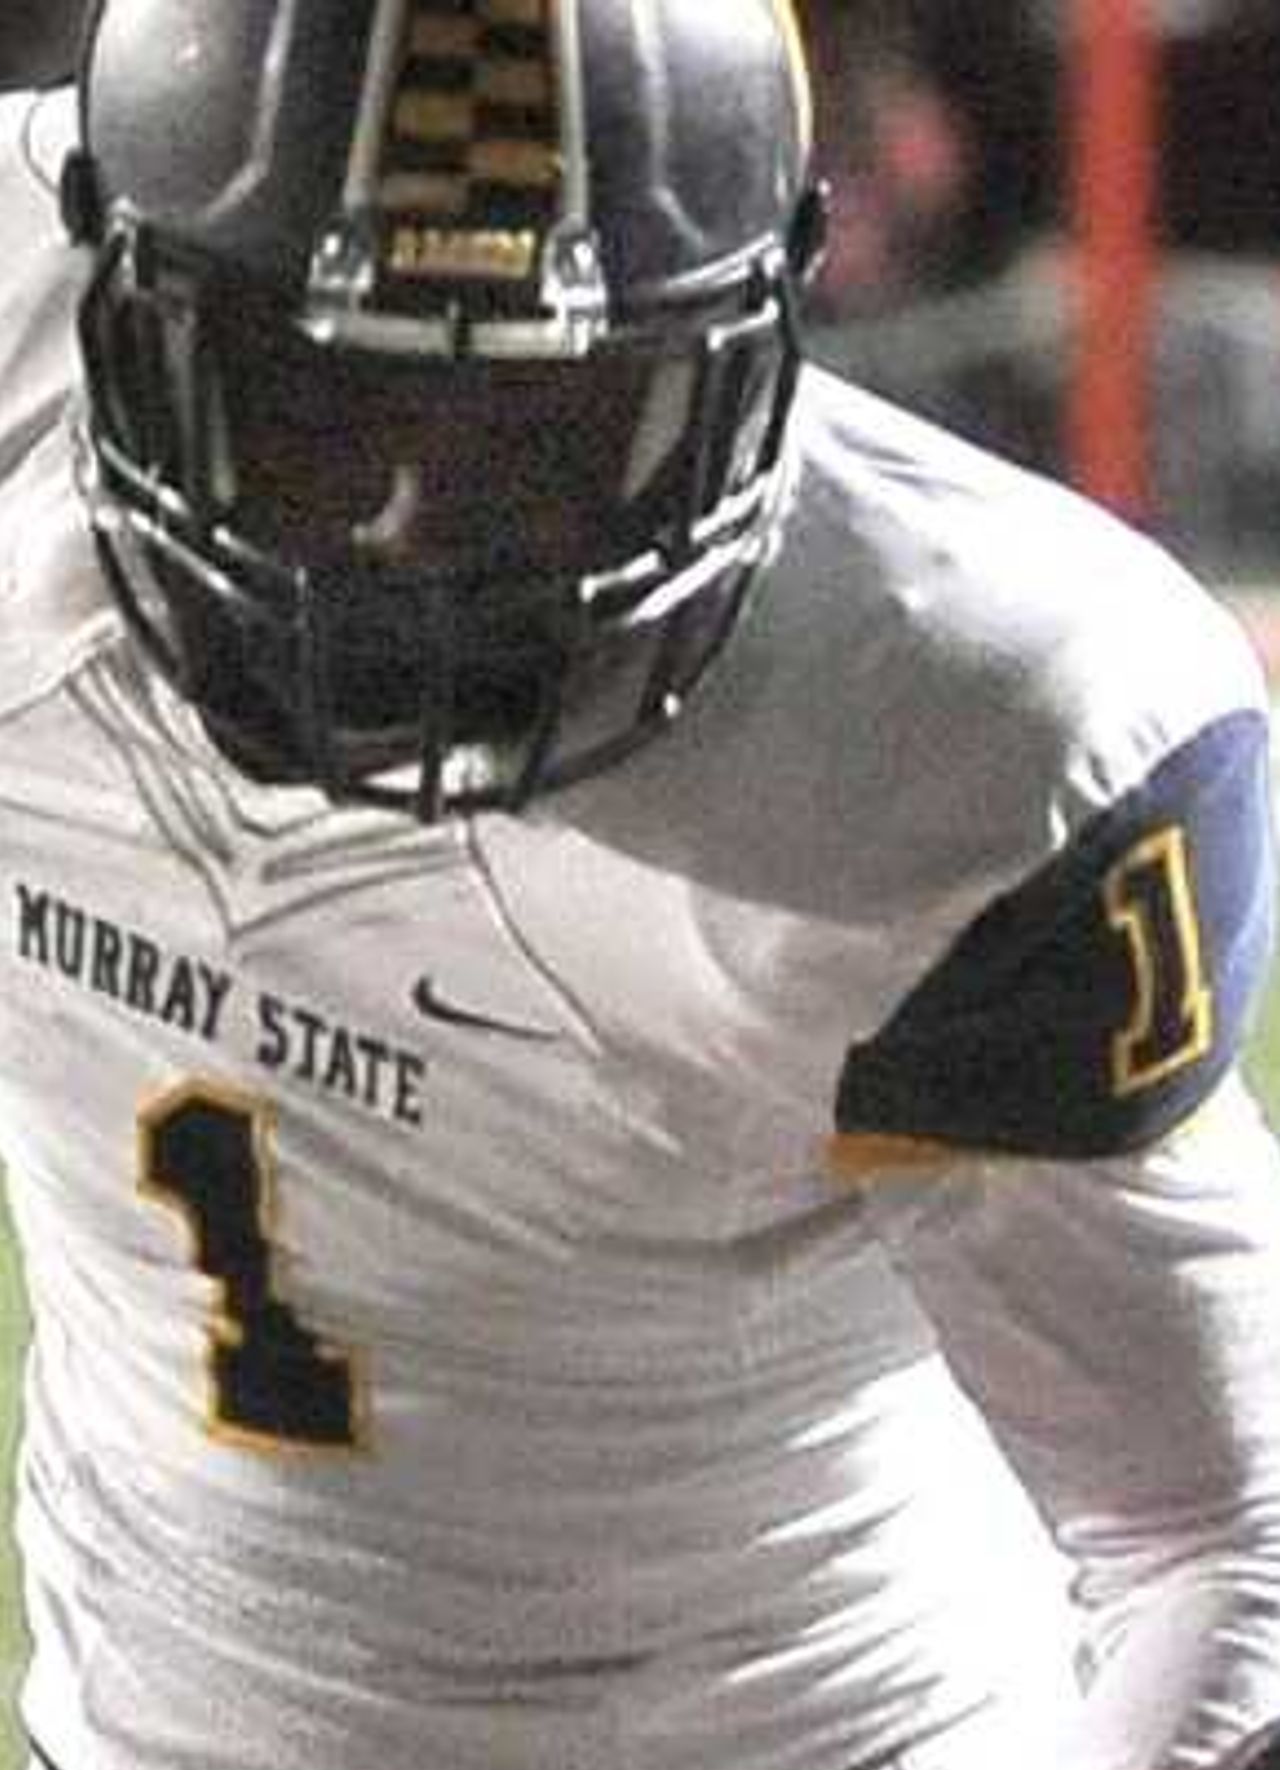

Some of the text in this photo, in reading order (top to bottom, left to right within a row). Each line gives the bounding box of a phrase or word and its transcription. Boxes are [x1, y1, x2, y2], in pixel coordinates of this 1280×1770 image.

[18, 885, 424, 1124] MURRAY STATE
[1104, 827, 1211, 1097] 1
[136, 1076, 374, 1457] 1
